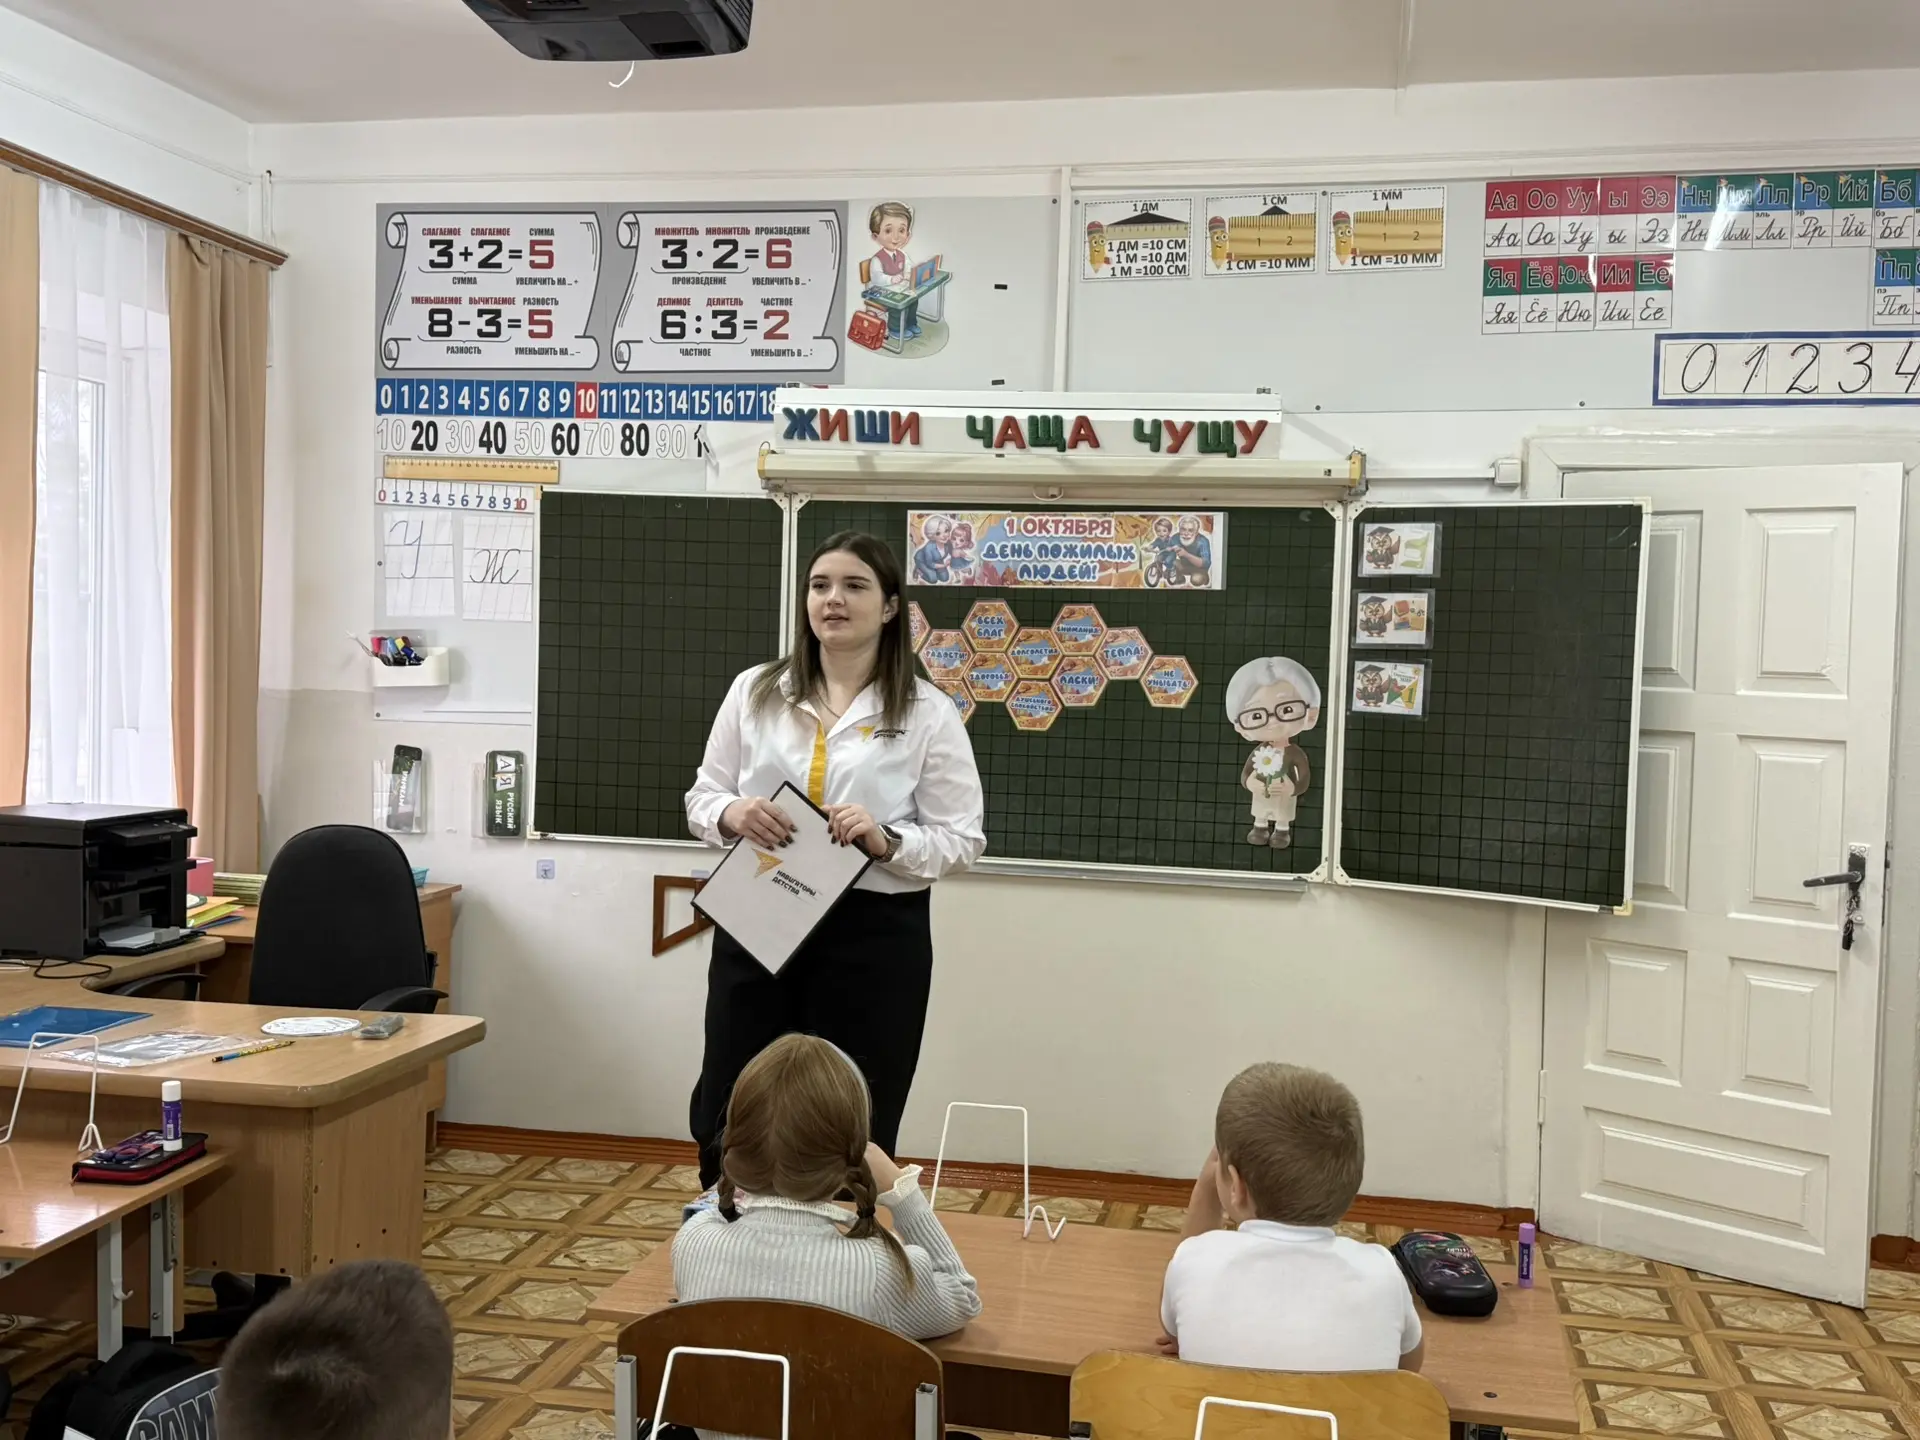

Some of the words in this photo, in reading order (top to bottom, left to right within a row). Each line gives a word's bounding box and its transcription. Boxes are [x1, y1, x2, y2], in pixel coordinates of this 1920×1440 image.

[1372, 192, 1378, 201] 1
[1382, 191, 1402, 200] ММ
[1489, 189, 1518, 211] Аа
[1528, 188, 1557, 209] Оо
[1566, 186, 1594, 213] Уу
[1608, 191, 1628, 208] ы
[1642, 186, 1670, 207] Ээ
[1681, 185, 1712, 207] Нн
[1757, 183, 1789, 205] Лл
[1800, 180, 1830, 208] Рр
[1838, 174, 1869, 202] Йй
[1880, 179, 1912, 202] Бб
[1133, 203, 1138, 212] 1
[1141, 203, 1159, 213] ДМ
[1262, 197, 1267, 205] 1
[1271, 196, 1287, 205] СМ
[422, 228, 461, 236] СЛАГАЕМОЕ
[471, 228, 510, 236] СЛАГАЕМОЕ
[529, 228, 554, 236] СУММА
[655, 227, 699, 236] МНОЖИТЕЛЬ
[705, 227, 750, 235] МНОЖИТЕЛЬ
[755, 227, 810, 236] ПРОИЗВЕДЕНИЕ
[1486, 222, 1521, 247] Аа
[1527, 222, 1555, 246] Оо
[1564, 222, 1593, 252] Уу
[1641, 218, 1669, 243] Ээ
[1756, 219, 1786, 240] Лл
[1798, 216, 1826, 246] Рр
[1840, 213, 1866, 236] Йй
[1880, 216, 1913, 239] Бб
[1108, 242, 1114, 252] 1
[1117, 241, 1138, 253] ДМ
[1166, 239, 1186, 250] СМ
[1116, 254, 1122, 264] 1
[1126, 253, 1137, 263] М
[1165, 252, 1187, 264] ДМ
[1226, 261, 1232, 270] 1
[1236, 259, 1256, 270] СМ
[1285, 257, 1310, 268] ММ
[1351, 256, 1357, 266] 1
[1361, 255, 1381, 265] СМ
[1412, 253, 1437, 263] ММ
[1111, 267, 1116, 276] 1
[1120, 266, 1132, 276] М
[1167, 264, 1186, 275] СМ
[1487, 267, 1517, 289] Яя
[1527, 261, 1554, 288] Ёё
[1601, 264, 1630, 285] Ии
[1639, 261, 1670, 284] Ее
[1880, 257, 1910, 280] Пп
[452, 277, 477, 285] СУММА
[516, 277, 555, 286] УВЕЛИЧИТЬ
[557, 277, 566, 286] НА
[672, 277, 726, 286] ПРОИЗВЕДЕНИЕ
[752, 277, 793, 285] УВЕЛИЧИТЬ
[411, 296, 462, 305] УМЕНЬШАЕМОЕ
[469, 297, 516, 305] ВЫЧИТАЕМОЕ
[523, 297, 559, 305] РАЗНОСТЬ
[657, 298, 691, 307] ДЕЛИМОЕ
[706, 298, 743, 307] ДЕЛИТЕЛЬ
[761, 298, 793, 306] ЧАСТНОЕ
[1877, 295, 1910, 315] Пп
[1486, 301, 1518, 324] Яя
[1525, 298, 1548, 322] Ёё
[1558, 300, 1592, 322] Юю
[1601, 300, 1630, 321] Ии
[1640, 297, 1665, 320] Ее
[446, 346, 482, 355] РАЗНОСТЬ
[515, 347, 558, 356] УМЕНЬШИТЬ
[559, 348, 568, 356] НА
[680, 348, 711, 357] ЧАСТНОЕ
[751, 349, 795, 357] УМЕНЬШИТЬ
[1681, 343, 1717, 393] 0
[1744, 343, 1768, 393] 1
[1786, 343, 1820, 393] 2
[1838, 342, 1872, 393] 3
[1895, 341, 1920, 393] 4
[381, 385, 392, 408] 0
[400, 385, 409, 409] 1
[418, 385, 429, 409] 2
[438, 386, 449, 410] 3
[458, 386, 471, 410] 4
[479, 387, 489, 410] 5
[499, 387, 510, 411] 6
[518, 387, 529, 411] 7
[538, 388, 550, 412] 8
[559, 388, 571, 412] 9
[578, 389, 596, 413] 10
[600, 389, 617, 413] 11
[622, 389, 640, 413] 12
[645, 390, 663, 414] 13
[668, 390, 688, 414] 14
[692, 390, 710, 415] 15
[714, 390, 733, 415] 16
[737, 391, 755, 415] 17
[376, 418, 406, 451] 10
[411, 420, 438, 451] 20
[446, 420, 475, 454] 30
[479, 421, 507, 454] 40
[514, 422, 544, 455] 50
[551, 423, 579, 456] 60
[584, 422, 614, 456] 70
[620, 423, 649, 456] 80
[655, 424, 686, 458] 90
[378, 490, 386, 502] 0
[392, 491, 399, 502] 1
[406, 492, 413, 503] 2
[419, 492, 427, 504] 3
[432, 493, 440, 505] 4
[448, 494, 455, 506] 5
[461, 495, 469, 507] 6
[476, 496, 483, 507] 7
[488, 496, 496, 508] 8
[503, 497, 511, 509] 9
[514, 498, 527, 510] 10
[1006, 520, 1015, 535] 1
[1022, 518, 1112, 536] ОКТЯБРЯ
[982, 543, 1033, 561] ДЕНЬ
[1039, 544, 1135, 561] ПОЖИЛЫХ
[1019, 561, 1098, 582] ЛЮДЕЙ!
[1104, 646, 1143, 658] ТЕПЛА!
[1060, 675, 1098, 685] ЛАСКИ!
[399, 771, 408, 807] МУЗЫКА
[507, 792, 516, 828] РУССКИЙ
[772, 876, 800, 895] ДЕТСТВА
[776, 870, 816, 896] НАВИГАТОРЫ
